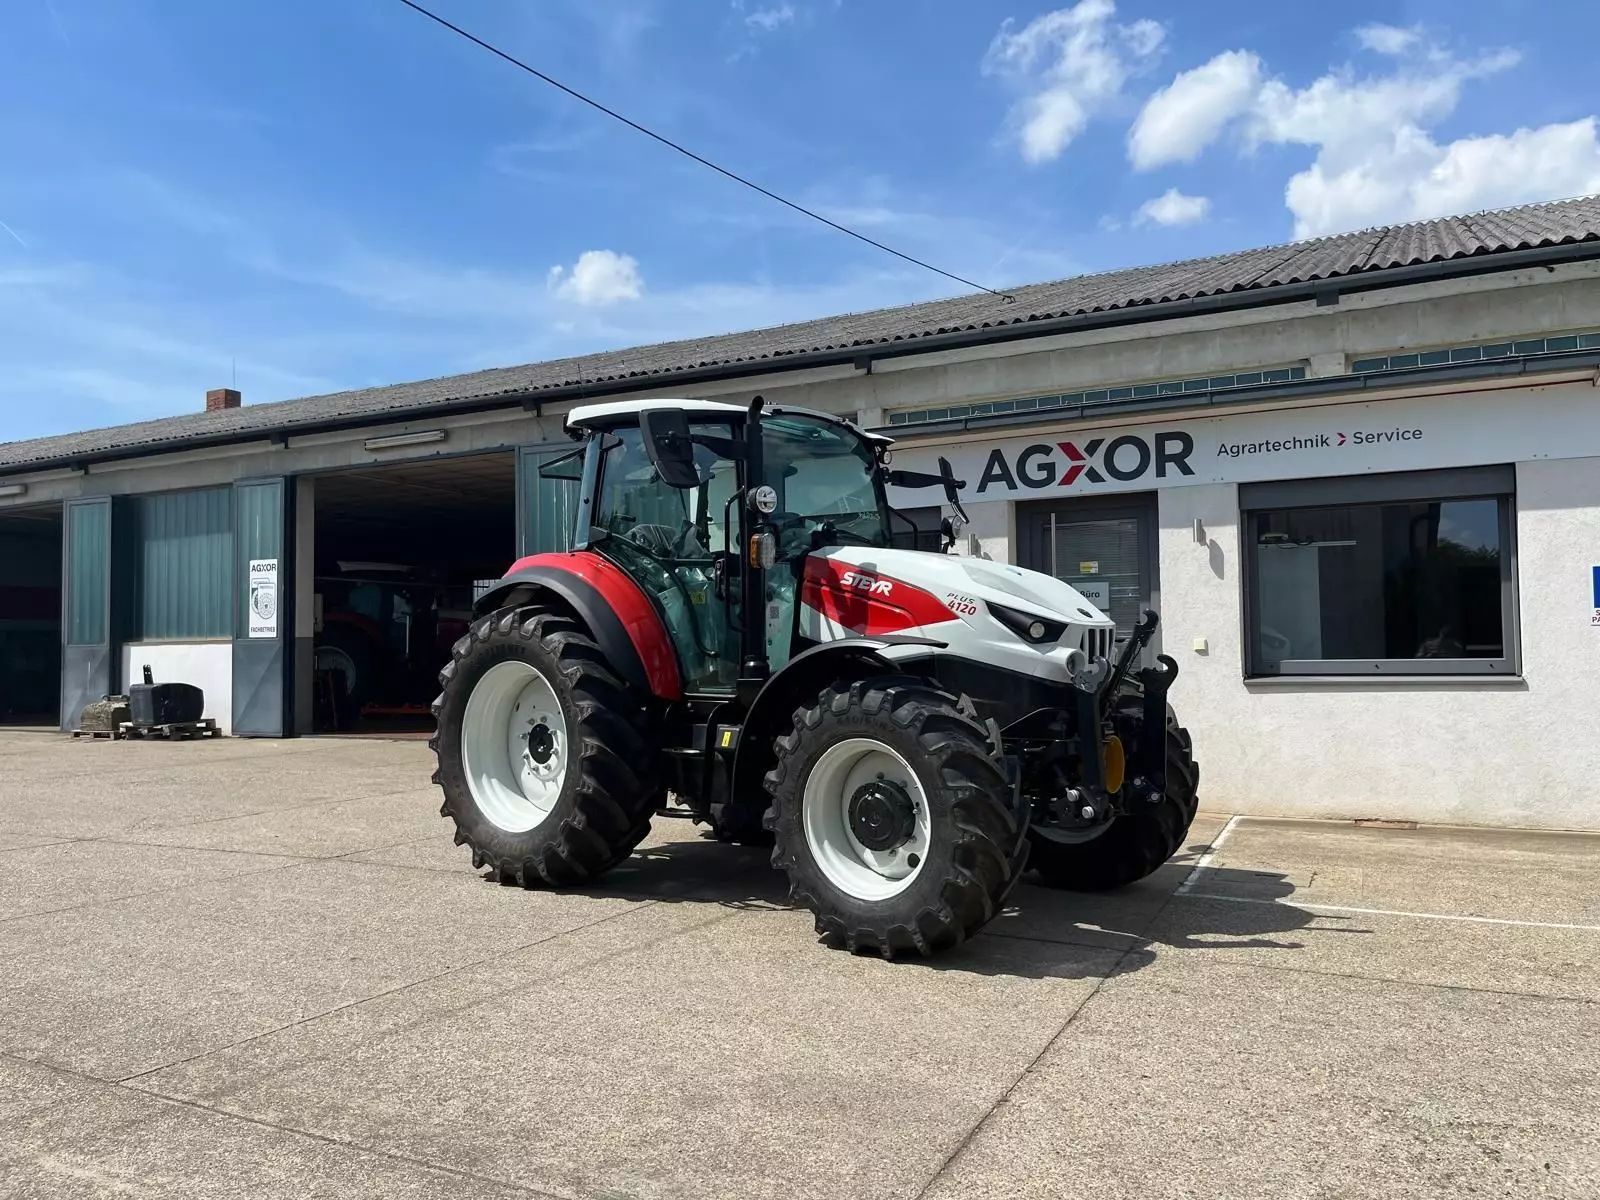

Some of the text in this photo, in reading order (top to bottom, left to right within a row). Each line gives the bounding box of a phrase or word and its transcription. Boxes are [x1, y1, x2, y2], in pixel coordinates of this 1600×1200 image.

[1217, 429, 1423, 458] Agrartechnik Service
[976, 431, 1195, 493] AGXOR
[251, 563, 277, 572] AGXOR
[840, 571, 893, 597] STEYR
[947, 592, 976, 605] PLUS
[947, 600, 977, 615] 4120
